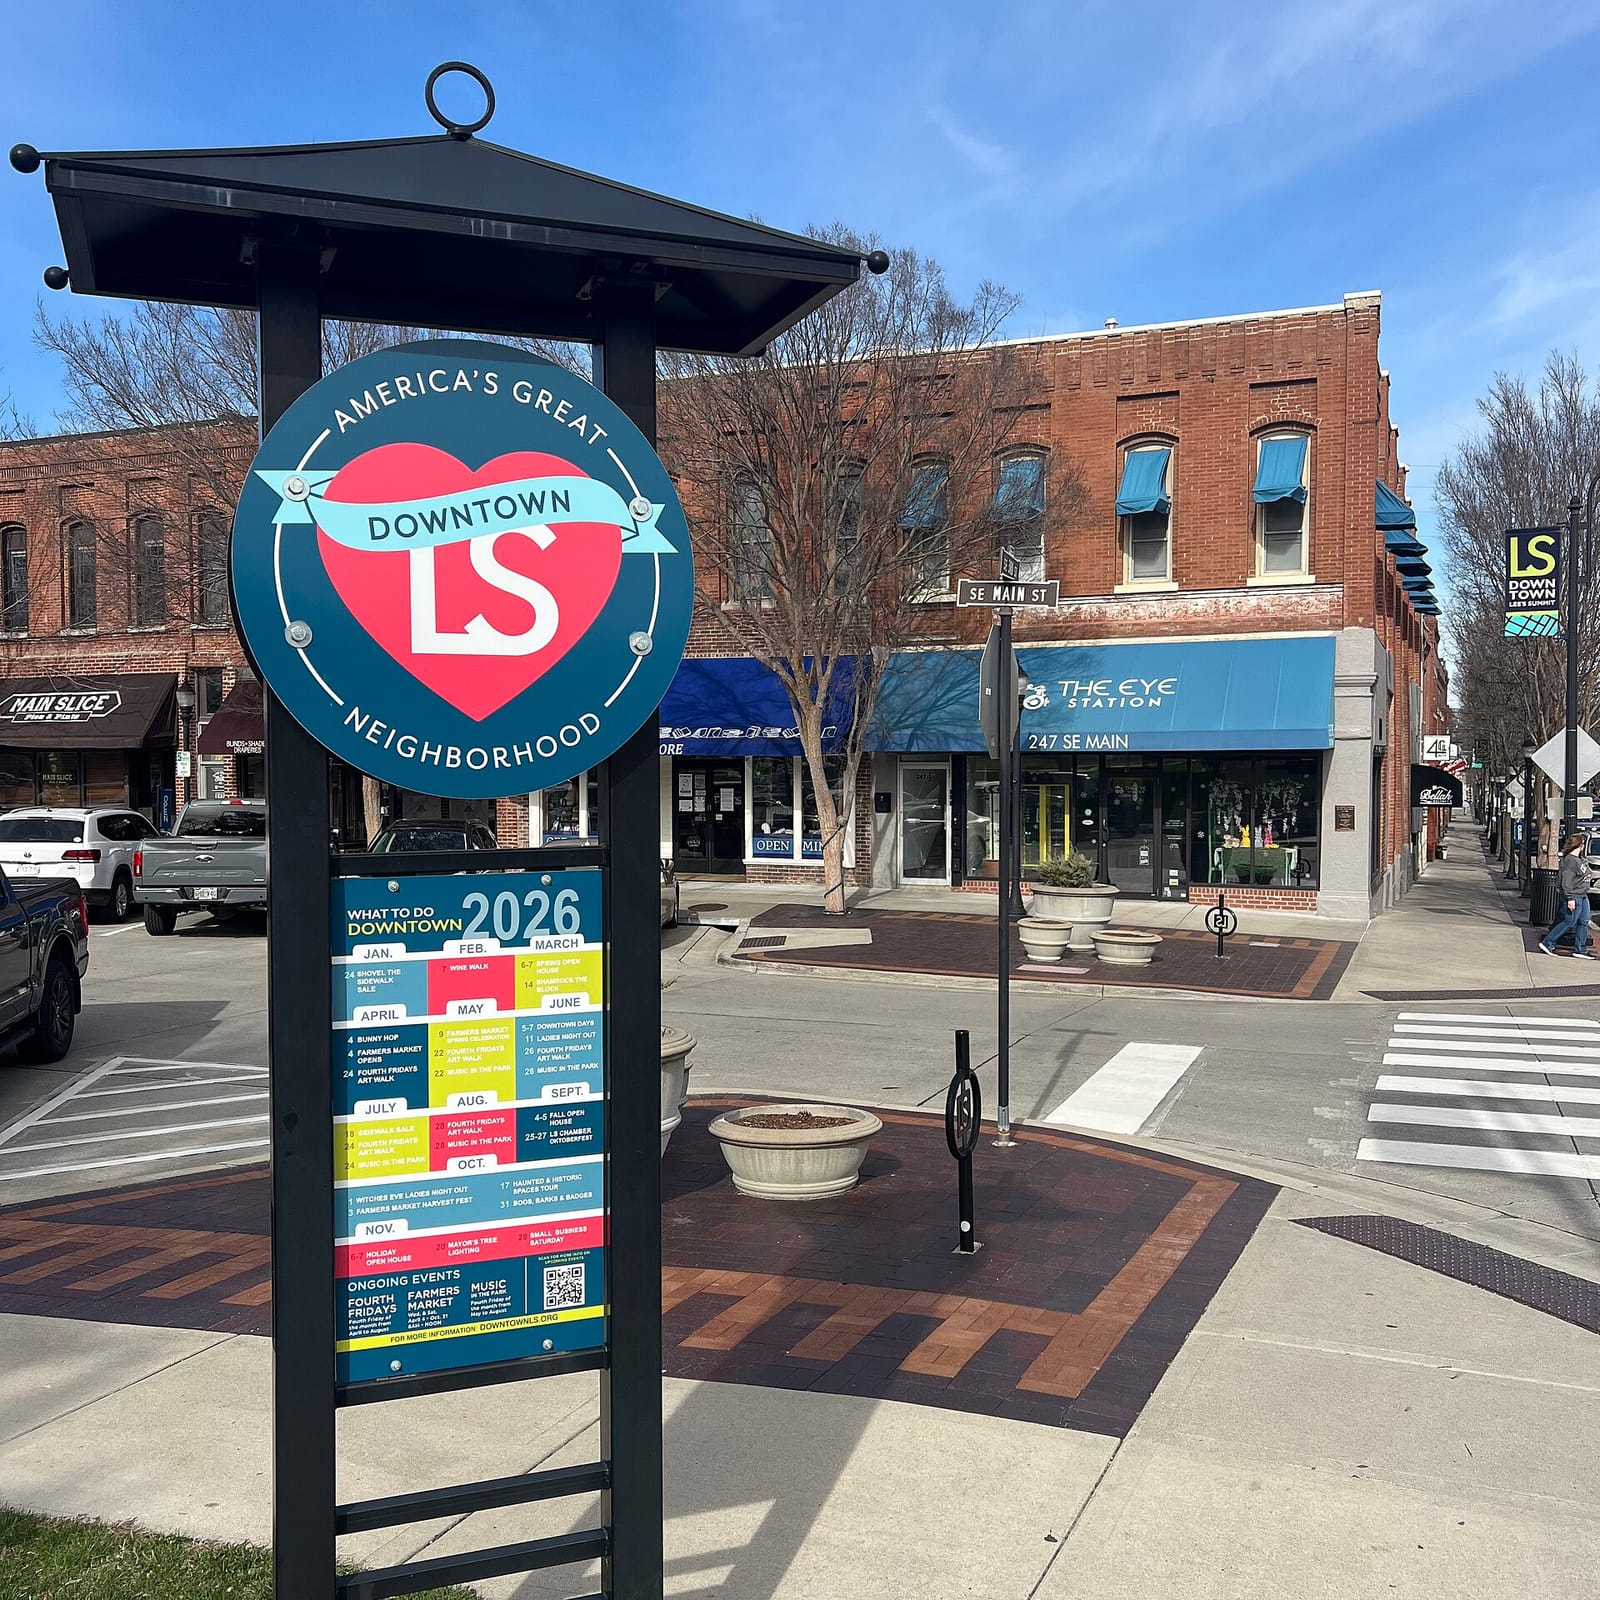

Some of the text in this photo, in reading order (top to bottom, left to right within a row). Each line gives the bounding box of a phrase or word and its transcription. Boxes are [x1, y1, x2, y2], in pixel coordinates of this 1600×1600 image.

[333, 368, 609, 446] AMERICA'S GREAT
[368, 489, 572, 541] DOWNTOWN
[1510, 534, 1556, 577] LS
[409, 524, 560, 656] LS
[1508, 578, 1556, 590] DOWN
[969, 585, 1047, 602] SE MAIN ST
[1508, 588, 1556, 600] TOWN
[1527, 599, 1556, 607] SUMMIT
[1058, 678, 1177, 697] THE EYE
[9, 695, 110, 712] MAIN SLICE
[1068, 697, 1162, 709] STATION
[343, 707, 601, 770] NEIGHBORHOOD
[1028, 734, 1128, 750] 247 SE MAIN
[756, 840, 790, 851] OPEN
[347, 907, 434, 920] WHAT TO DO
[461, 888, 581, 940] 2026
[348, 918, 462, 936] DOWNTOWN
[459, 943, 487, 954] FEB.
[535, 939, 579, 950] MARCH
[364, 948, 393, 959] JAN.
[521, 961, 533, 969] 6-7
[344, 971, 355, 979] 24
[357, 977, 394, 985] SIDEWALK
[357, 985, 376, 993] SALE
[550, 997, 581, 1009] JUNE
[361, 1010, 399, 1021] APRIL
[458, 1004, 484, 1015] MAY
[521, 1024, 534, 1032] 5-7
[537, 1021, 576, 1029] DOWNTOWN
[347, 1036, 354, 1044] 4
[357, 1035, 382, 1043] BUNNY
[357, 1048, 391, 1056] FARMERS
[524, 1047, 534, 1055] 26
[564, 1044, 592, 1052] FRIDAYS
[357, 1056, 382, 1064] OPENS
[357, 1068, 386, 1076] FOURTH
[388, 1066, 418, 1074] FRIDAYS
[524, 1067, 535, 1075] 26
[537, 1066, 558, 1074] MUSIC
[581, 1062, 599, 1070] PARK
[551, 1086, 583, 1098] SEPT.
[457, 1095, 487, 1107] AUG.
[365, 1102, 397, 1115] JULY
[447, 1120, 475, 1128] FOURTH
[476, 1117, 505, 1125] FRIDAYS
[534, 1113, 547, 1121] 4-5
[549, 1118, 573, 1126] HOUSE
[525, 1132, 547, 1141] 25-27
[559, 1127, 592, 1136] CHAMBER
[549, 1135, 593, 1144] OKTOBERFEST
[447, 1140, 469, 1148] MUSIC
[458, 1158, 485, 1170] OCT.
[500, 1182, 510, 1190] 17
[513, 1178, 544, 1187] HAUNTED
[552, 1174, 582, 1183] HISTORIC
[355, 1195, 388, 1204] WITCHES
[405, 1191, 430, 1199] LADIES
[431, 1188, 453, 1196] NIGHT
[513, 1186, 539, 1194] SPACES
[535, 1196, 558, 1204] BARKS
[565, 1192, 593, 1200] BADGES
[356, 1206, 390, 1215] FARMERS
[391, 1203, 420, 1211] MARKET
[422, 1199, 454, 1208] HARVEST
[365, 1223, 395, 1235] NOV.
[555, 1226, 587, 1235] BUSINESS
[448, 1239, 478, 1248] MAYOR'S
[479, 1236, 498, 1244] TREE
[530, 1237, 564, 1246] SATURDAY
[366, 1249, 397, 1258] HOLIDAY
[448, 1247, 480, 1256] LIGHTING
[366, 1257, 386, 1265] OPEN
[348, 1270, 460, 1291] ONGOING EVENTS
[471, 1279, 506, 1292] MUSIC
[408, 1286, 460, 1300] FARMERS
[348, 1294, 394, 1308] FOURTH
[408, 1297, 453, 1311] MARKET
[348, 1304, 397, 1318] FRIDAYS
[406, 1332, 427, 1341] MORE
[480, 1314, 558, 1331] DOWNTOWNLS.ORG
